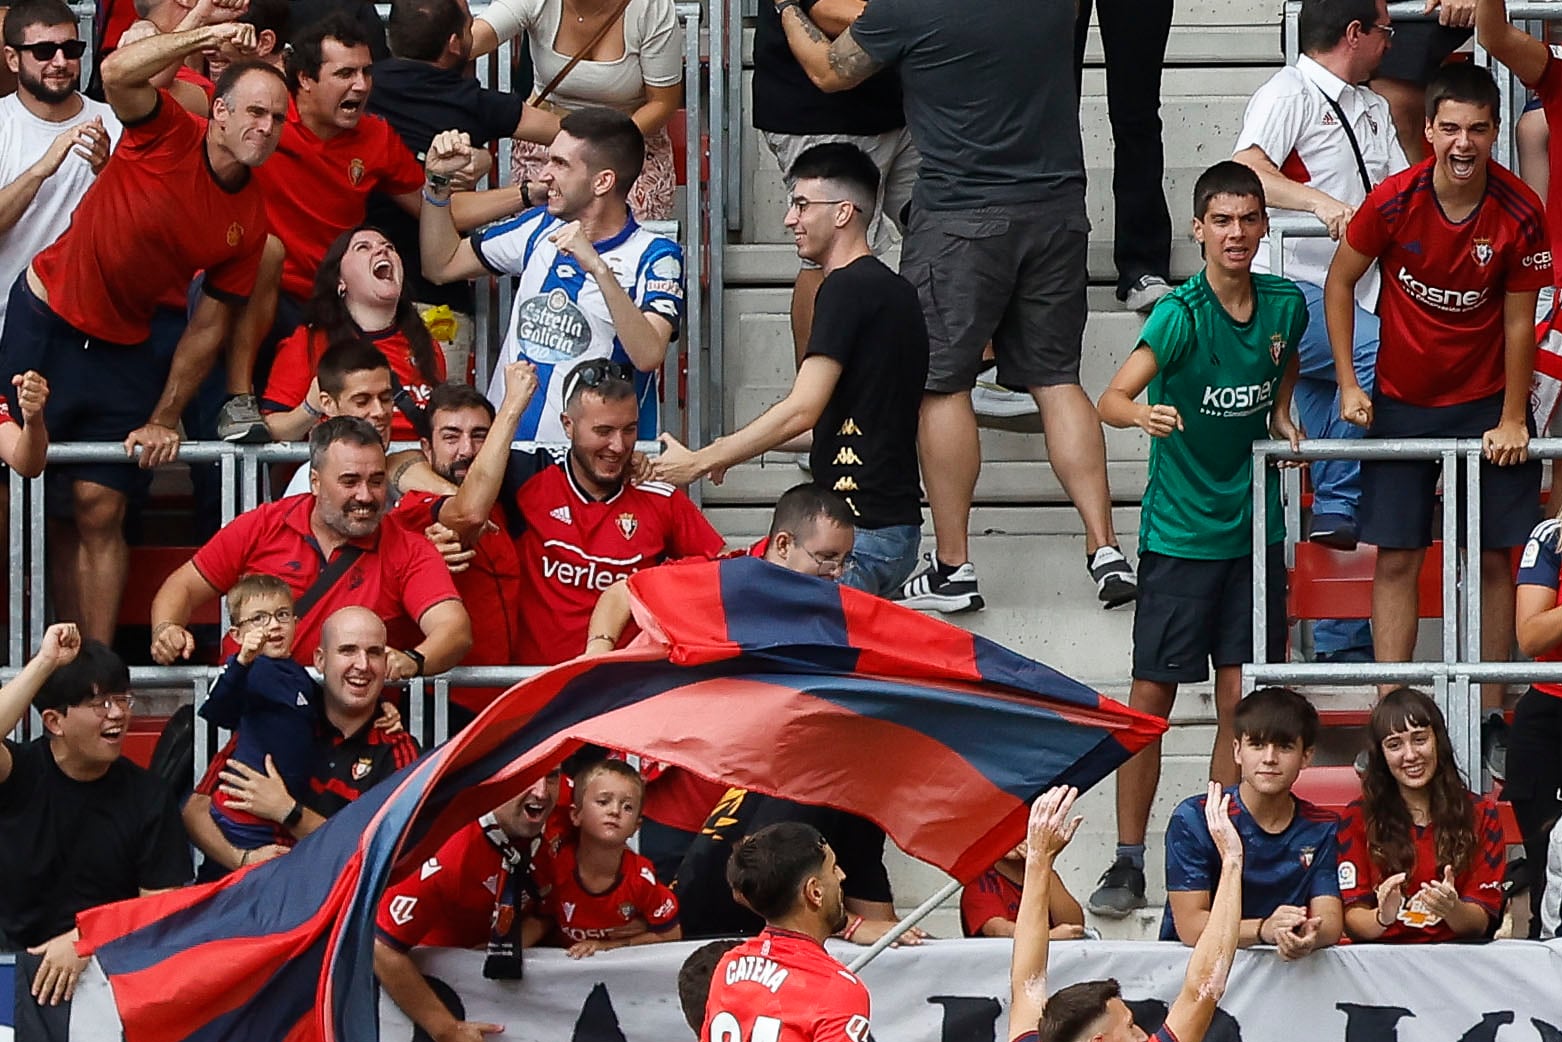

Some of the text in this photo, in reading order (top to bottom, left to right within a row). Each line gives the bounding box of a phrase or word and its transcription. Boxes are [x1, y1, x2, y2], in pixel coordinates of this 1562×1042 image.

[520, 322, 574, 354] Galicia
[526, 302, 583, 338] Estrella
[542, 555, 639, 592] verlea
[725, 955, 788, 994] CATENA
